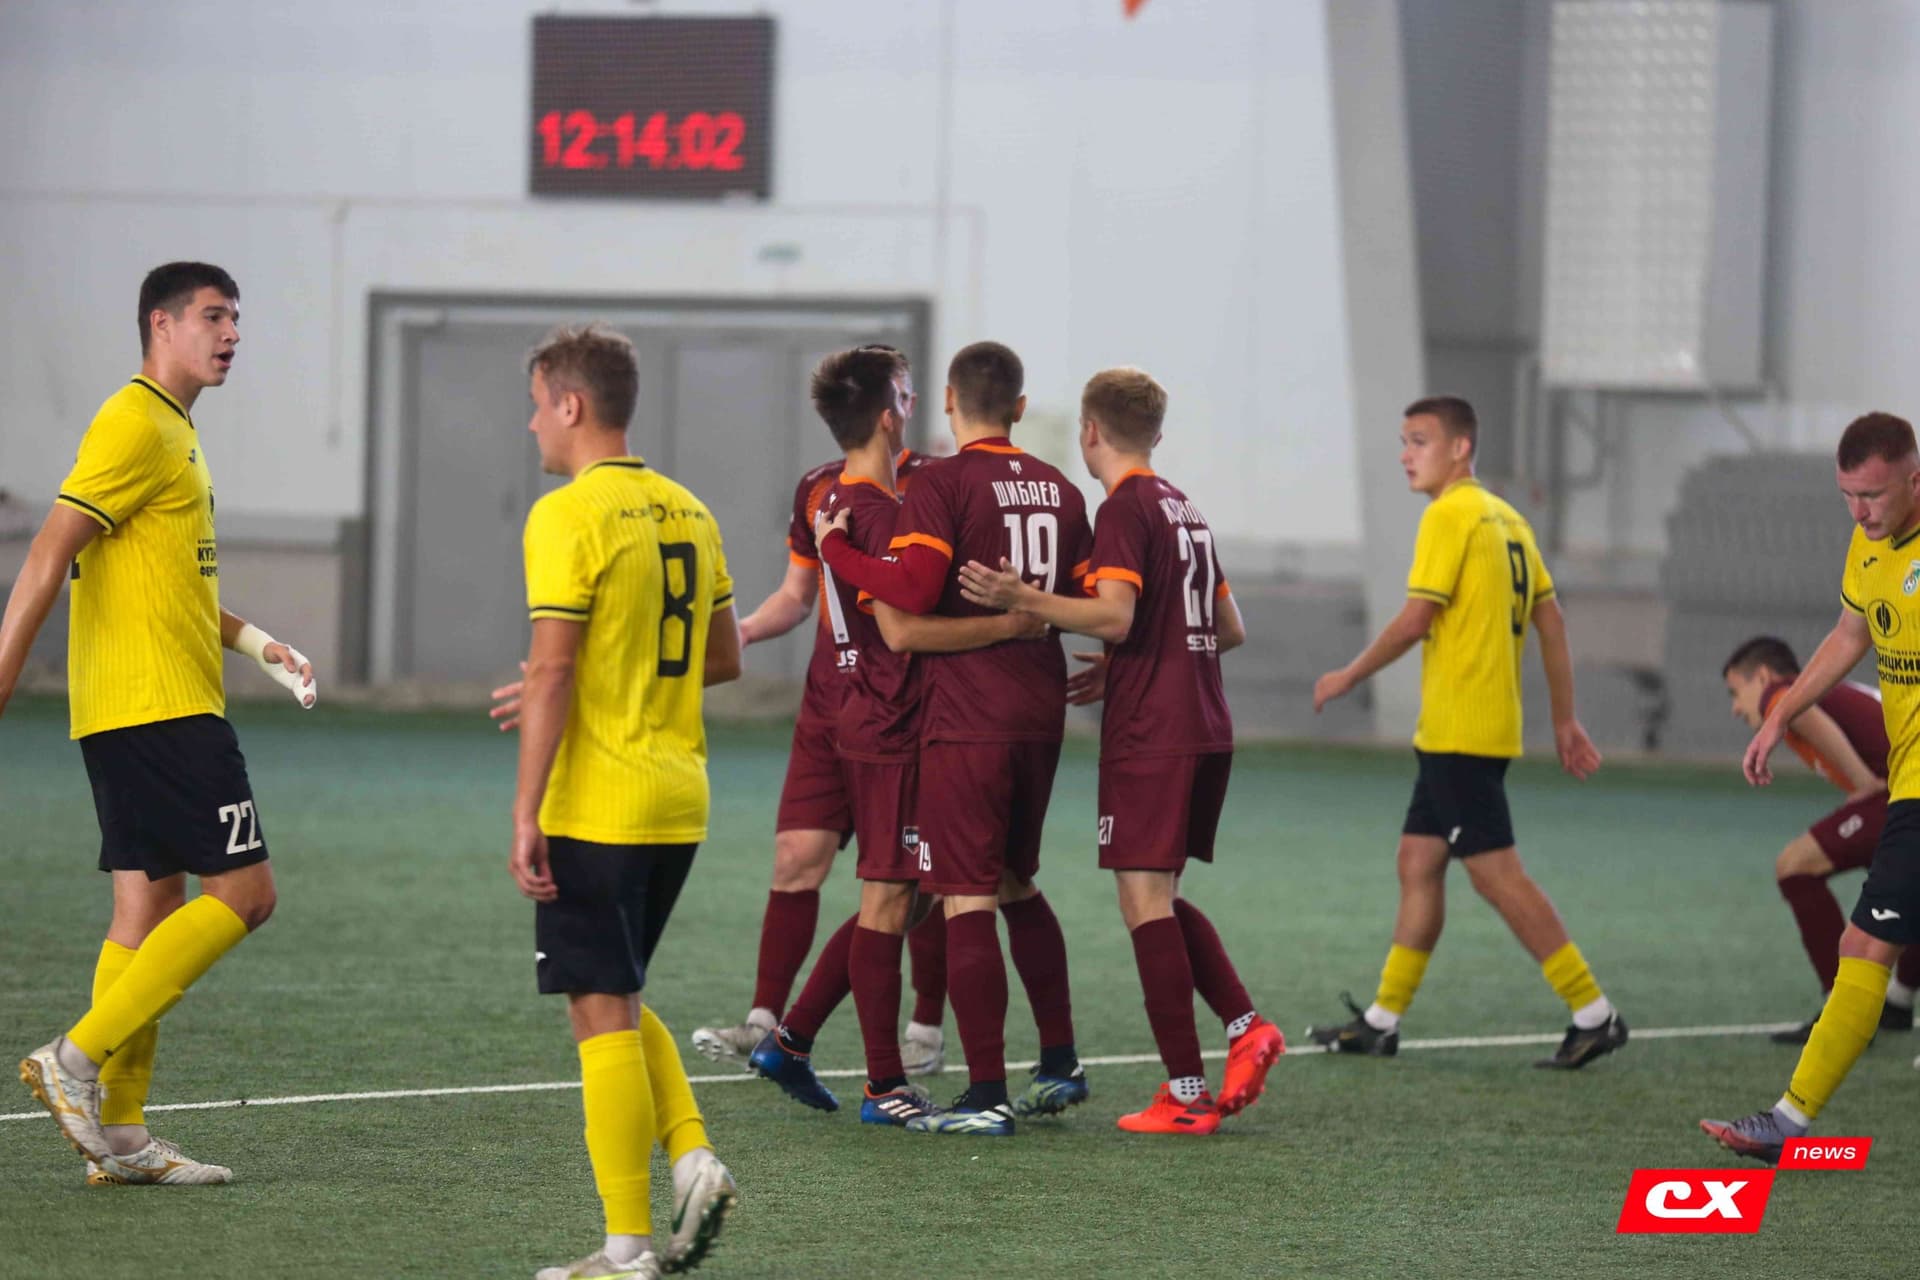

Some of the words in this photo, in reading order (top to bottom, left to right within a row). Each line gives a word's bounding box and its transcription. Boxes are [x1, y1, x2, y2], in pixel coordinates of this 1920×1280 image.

[537, 109, 747, 171] 12:14:02
[992, 480, 1061, 507] ШИБАЕВ
[1003, 512, 1058, 594] 19
[1177, 526, 1216, 628] 27
[656, 541, 697, 678] 8
[1506, 541, 1529, 636] 9
[218, 800, 263, 855] 22
[919, 841, 932, 871] 19
[1099, 815, 1114, 845] 27
